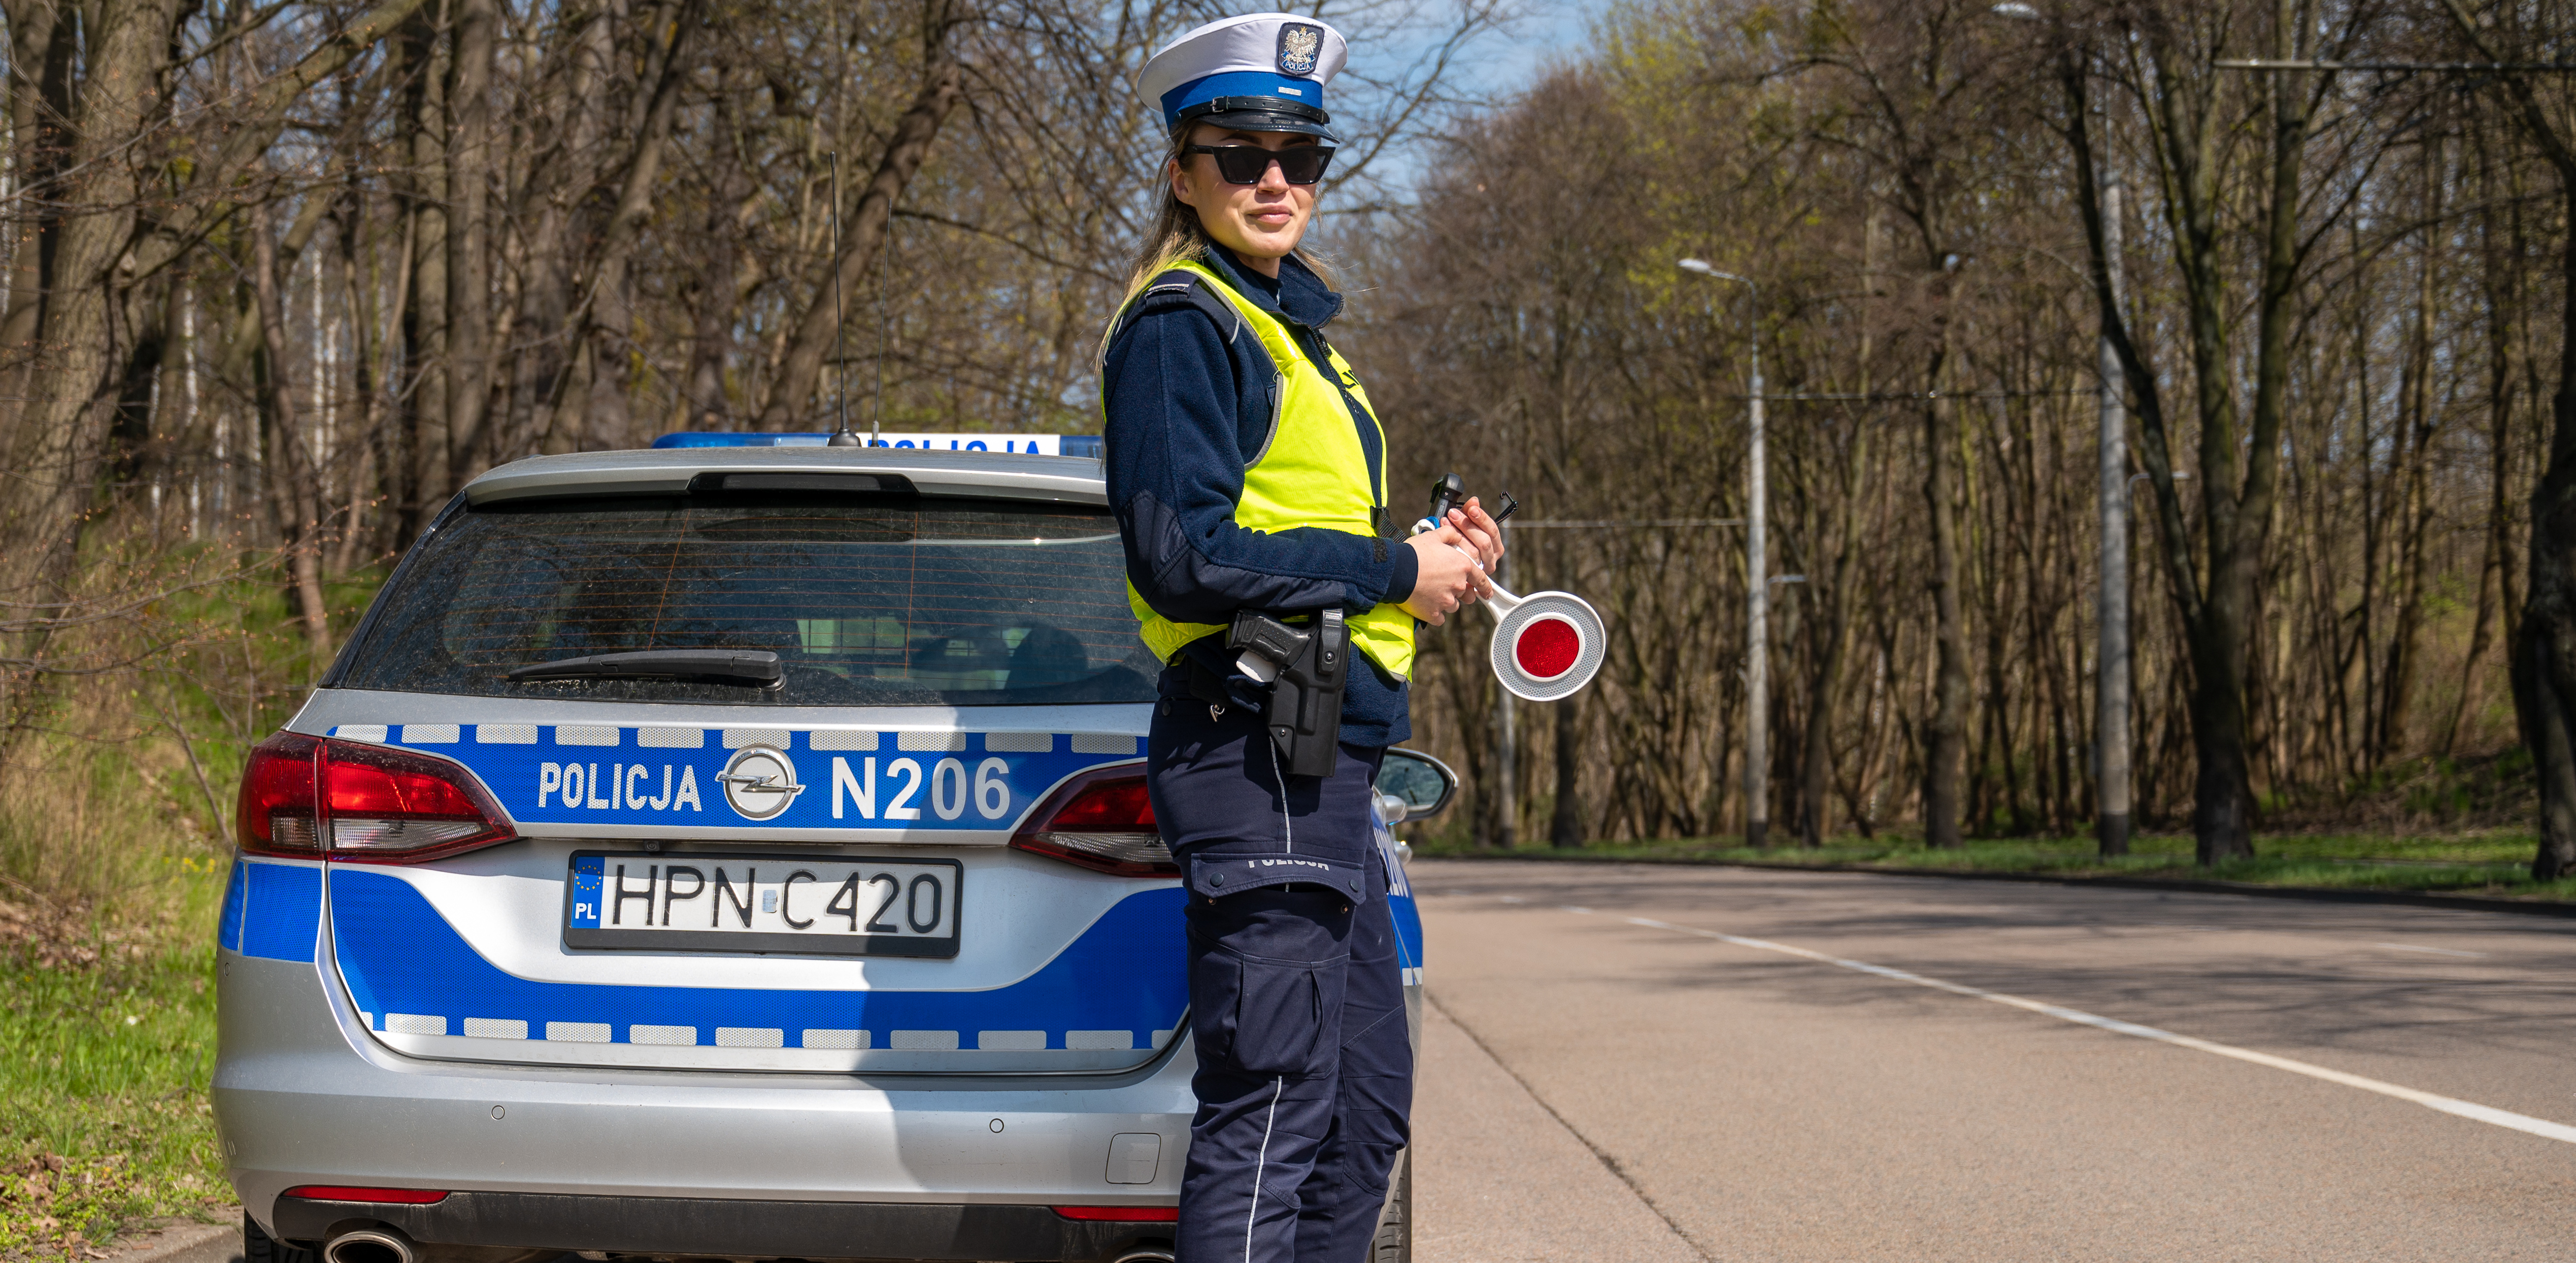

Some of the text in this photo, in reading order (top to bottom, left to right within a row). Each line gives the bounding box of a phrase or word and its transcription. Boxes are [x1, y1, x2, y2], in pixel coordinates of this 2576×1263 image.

[1285, 61, 1311, 71] POLICJA
[539, 762, 702, 812] POLICJA
[832, 757, 1010, 820] N206
[575, 903, 596, 919] PL
[612, 864, 942, 934] HPN C420
